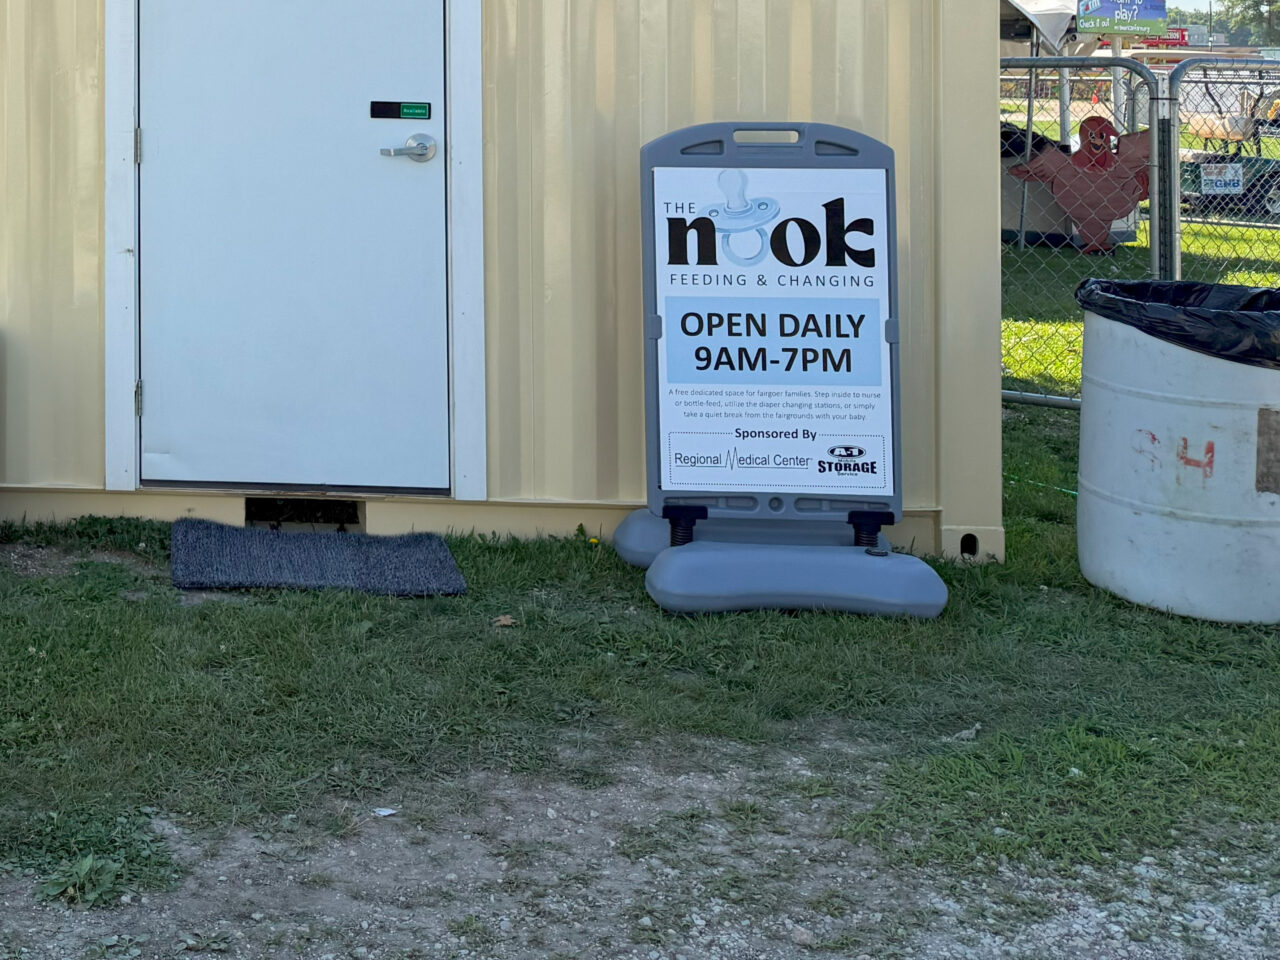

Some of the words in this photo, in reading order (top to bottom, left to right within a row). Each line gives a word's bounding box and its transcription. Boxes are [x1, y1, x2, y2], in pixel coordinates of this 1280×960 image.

[1115, 4, 1138, 23] play?
[1080, 19, 1095, 28] Check
[664, 202, 696, 214] THE
[671, 274, 747, 286] FEEDING
[757, 274, 768, 286] &
[777, 275, 874, 287] CHANGING
[680, 312, 766, 337] OPEN
[779, 313, 865, 338] DAILY
[694, 346, 852, 372] 9AM-7PM
[757, 390, 783, 398] fairgoer
[759, 401, 780, 409] diaper
[782, 401, 812, 409] changing
[853, 402, 875, 410] simply
[775, 412, 813, 420] fairgrounds
[832, 413, 847, 421] your
[735, 428, 798, 440] Sponsored
[802, 429, 816, 441] By
[675, 452, 721, 467] Regional
[725, 446, 770, 470] Medical
[773, 454, 810, 467] Center
[833, 448, 859, 456] A-1
[818, 460, 877, 474] STORAGE
